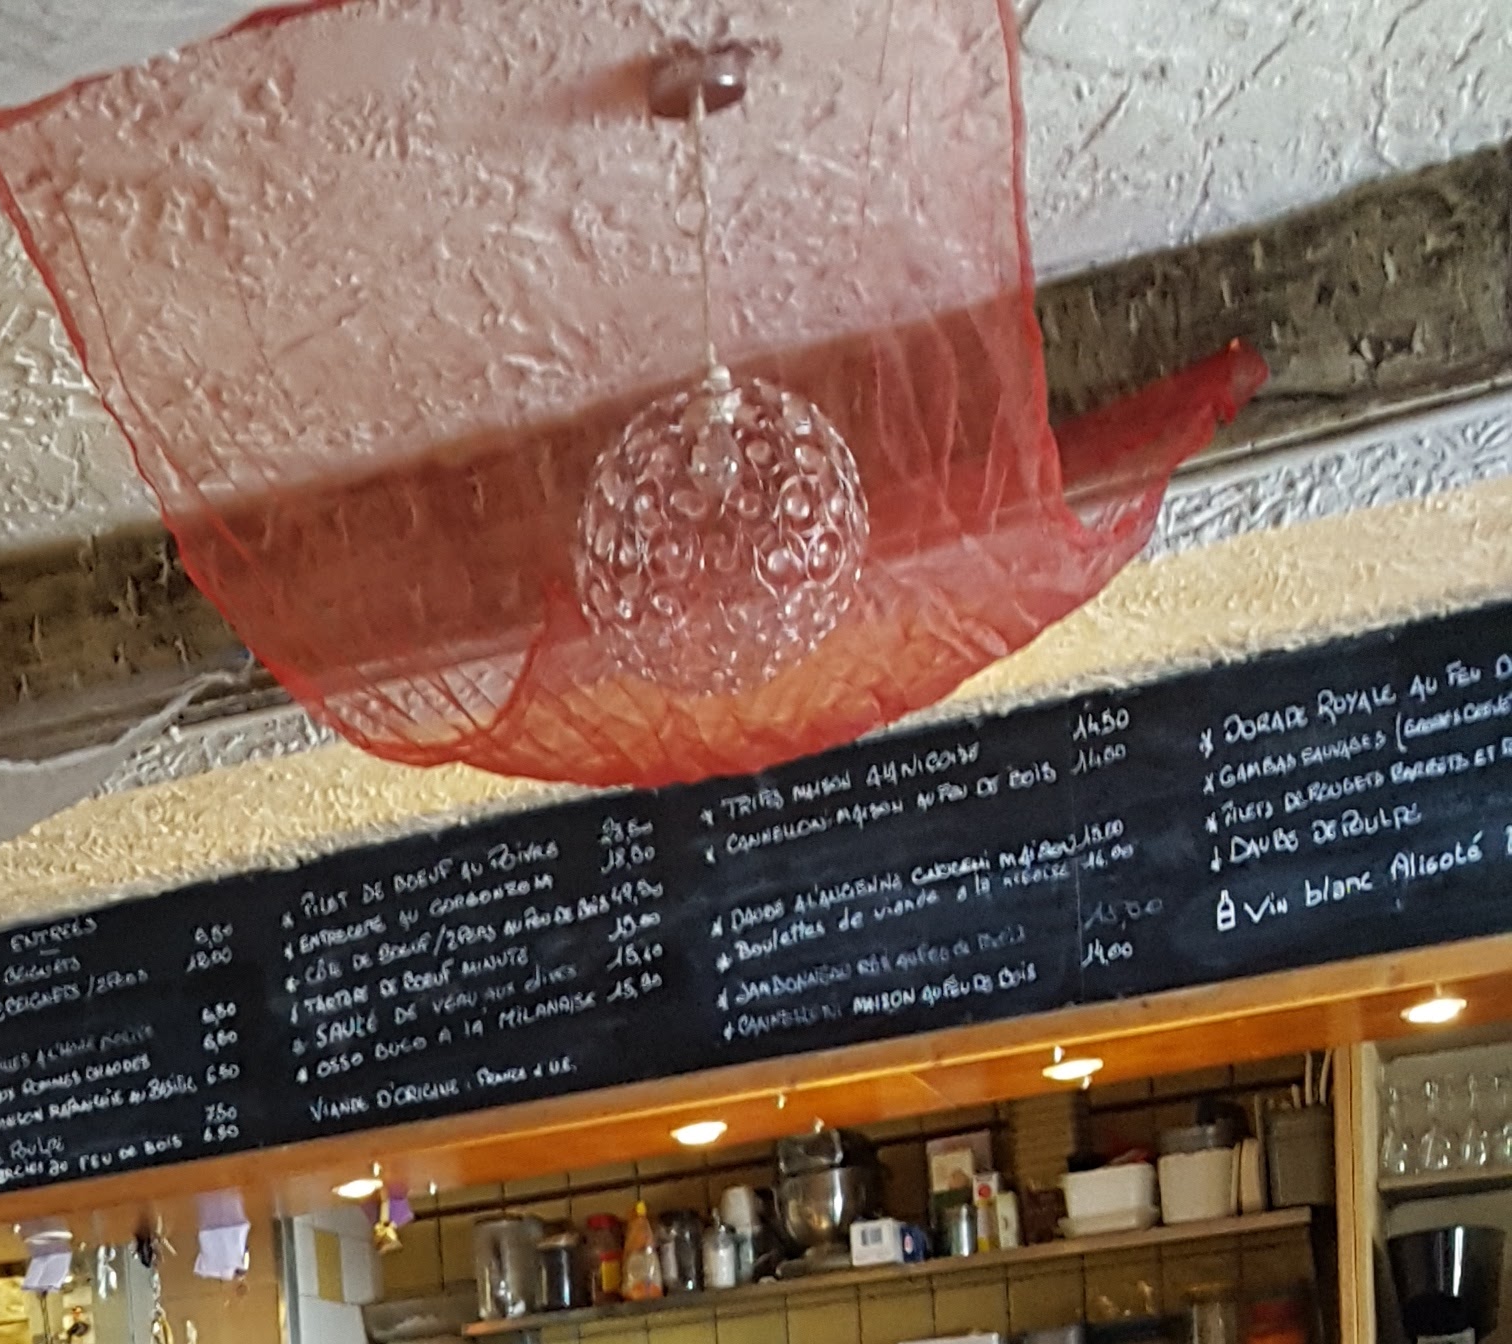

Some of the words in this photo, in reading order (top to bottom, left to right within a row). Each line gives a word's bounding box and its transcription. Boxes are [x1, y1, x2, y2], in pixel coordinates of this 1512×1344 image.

[1316, 683, 1397, 727] ROYALE
[1409, 674, 1438, 702] AU
[1304, 871, 1373, 908] blanc
[1390, 829, 1485, 881] Aligoté
